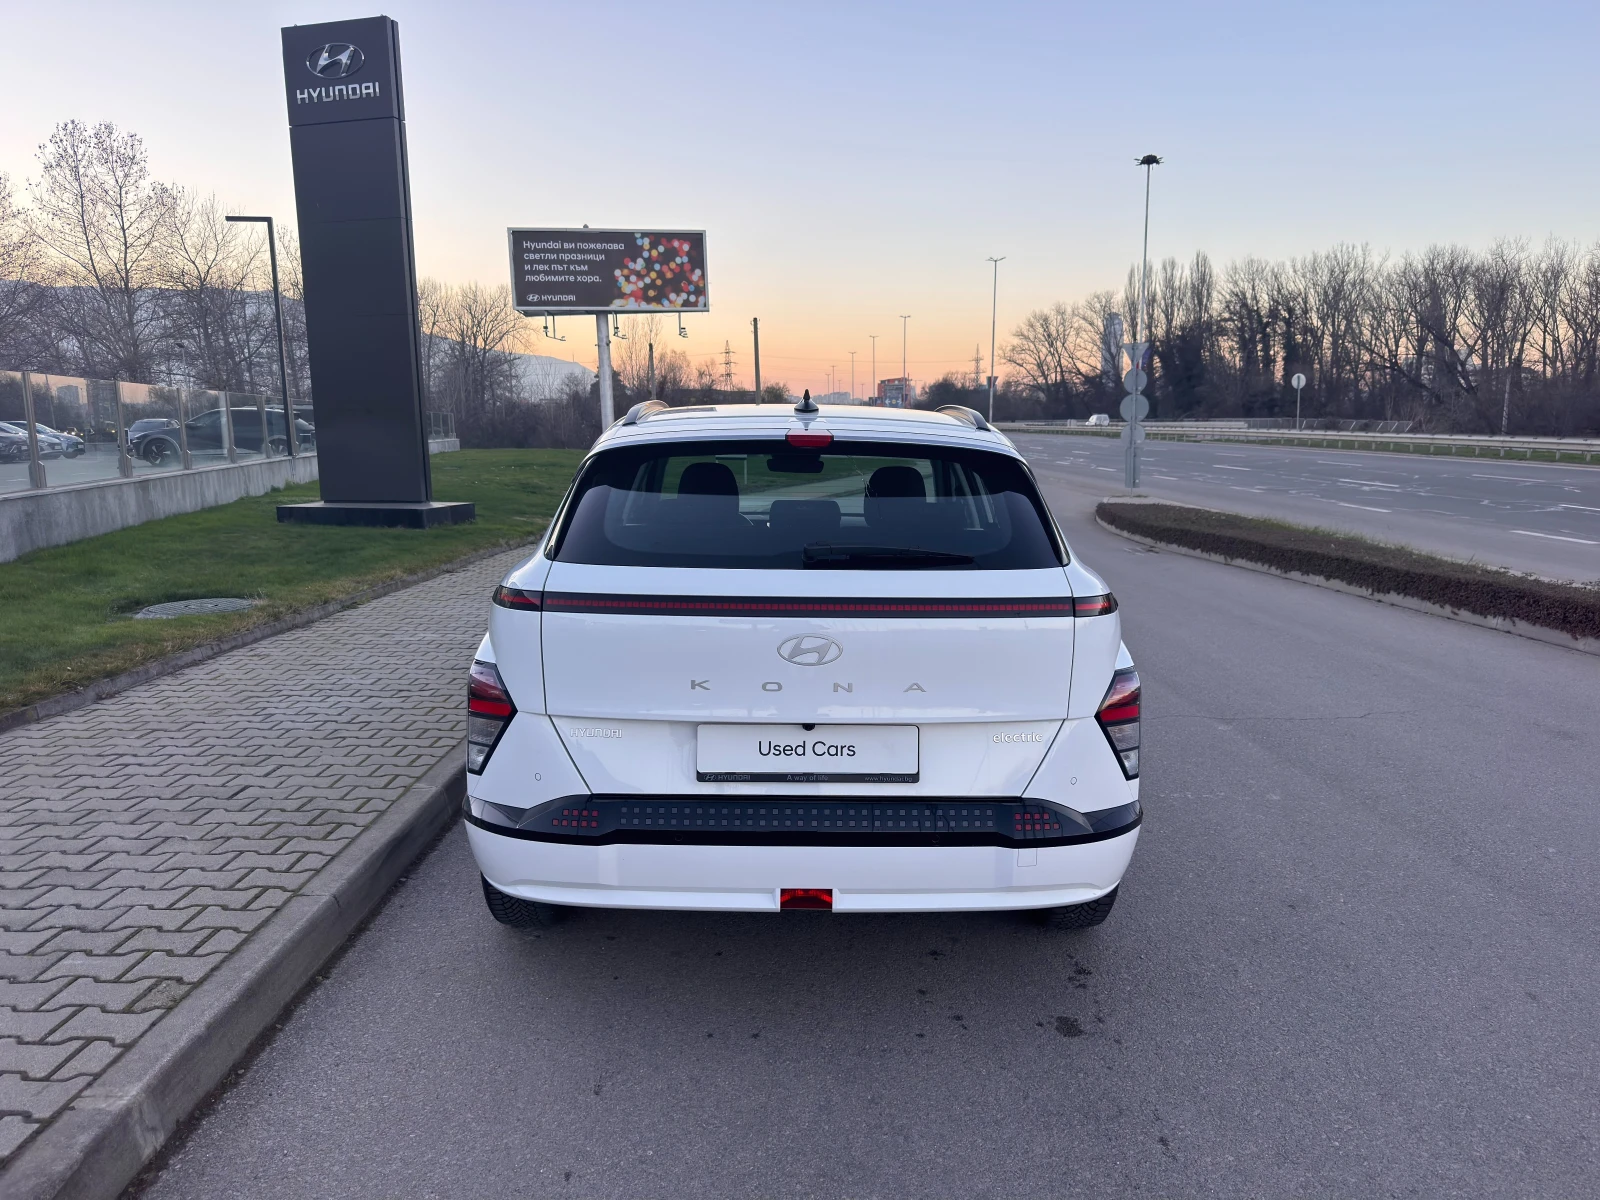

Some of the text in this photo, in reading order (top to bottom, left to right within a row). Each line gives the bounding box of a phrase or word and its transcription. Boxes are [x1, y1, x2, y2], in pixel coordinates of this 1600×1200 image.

[296, 81, 380, 104] HYUNDAI
[523, 241, 562, 250] Hyundai
[577, 242, 625, 250] пожелава
[558, 253, 605, 261] празници
[525, 273, 602, 283] любимите хора.
[570, 728, 622, 738] HYUNDAI
[993, 732, 1043, 743] electric
[758, 740, 856, 757] Used Cars
